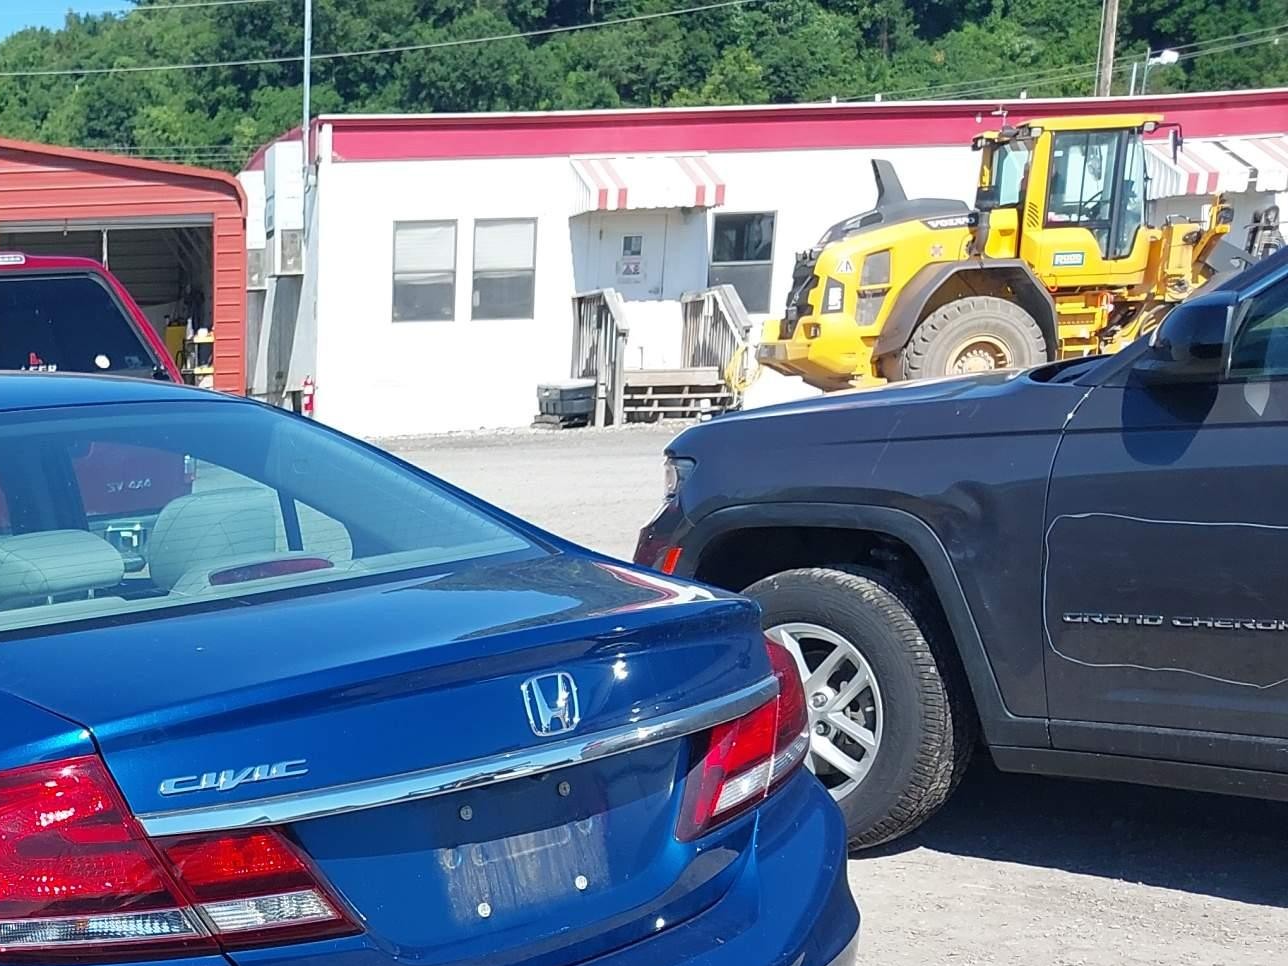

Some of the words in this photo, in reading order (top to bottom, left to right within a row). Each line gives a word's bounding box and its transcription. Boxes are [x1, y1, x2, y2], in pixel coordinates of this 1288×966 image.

[927, 216, 976, 228] VOLVO
[1063, 612, 1163, 625] GRAND
[160, 758, 309, 796] CIVIC
